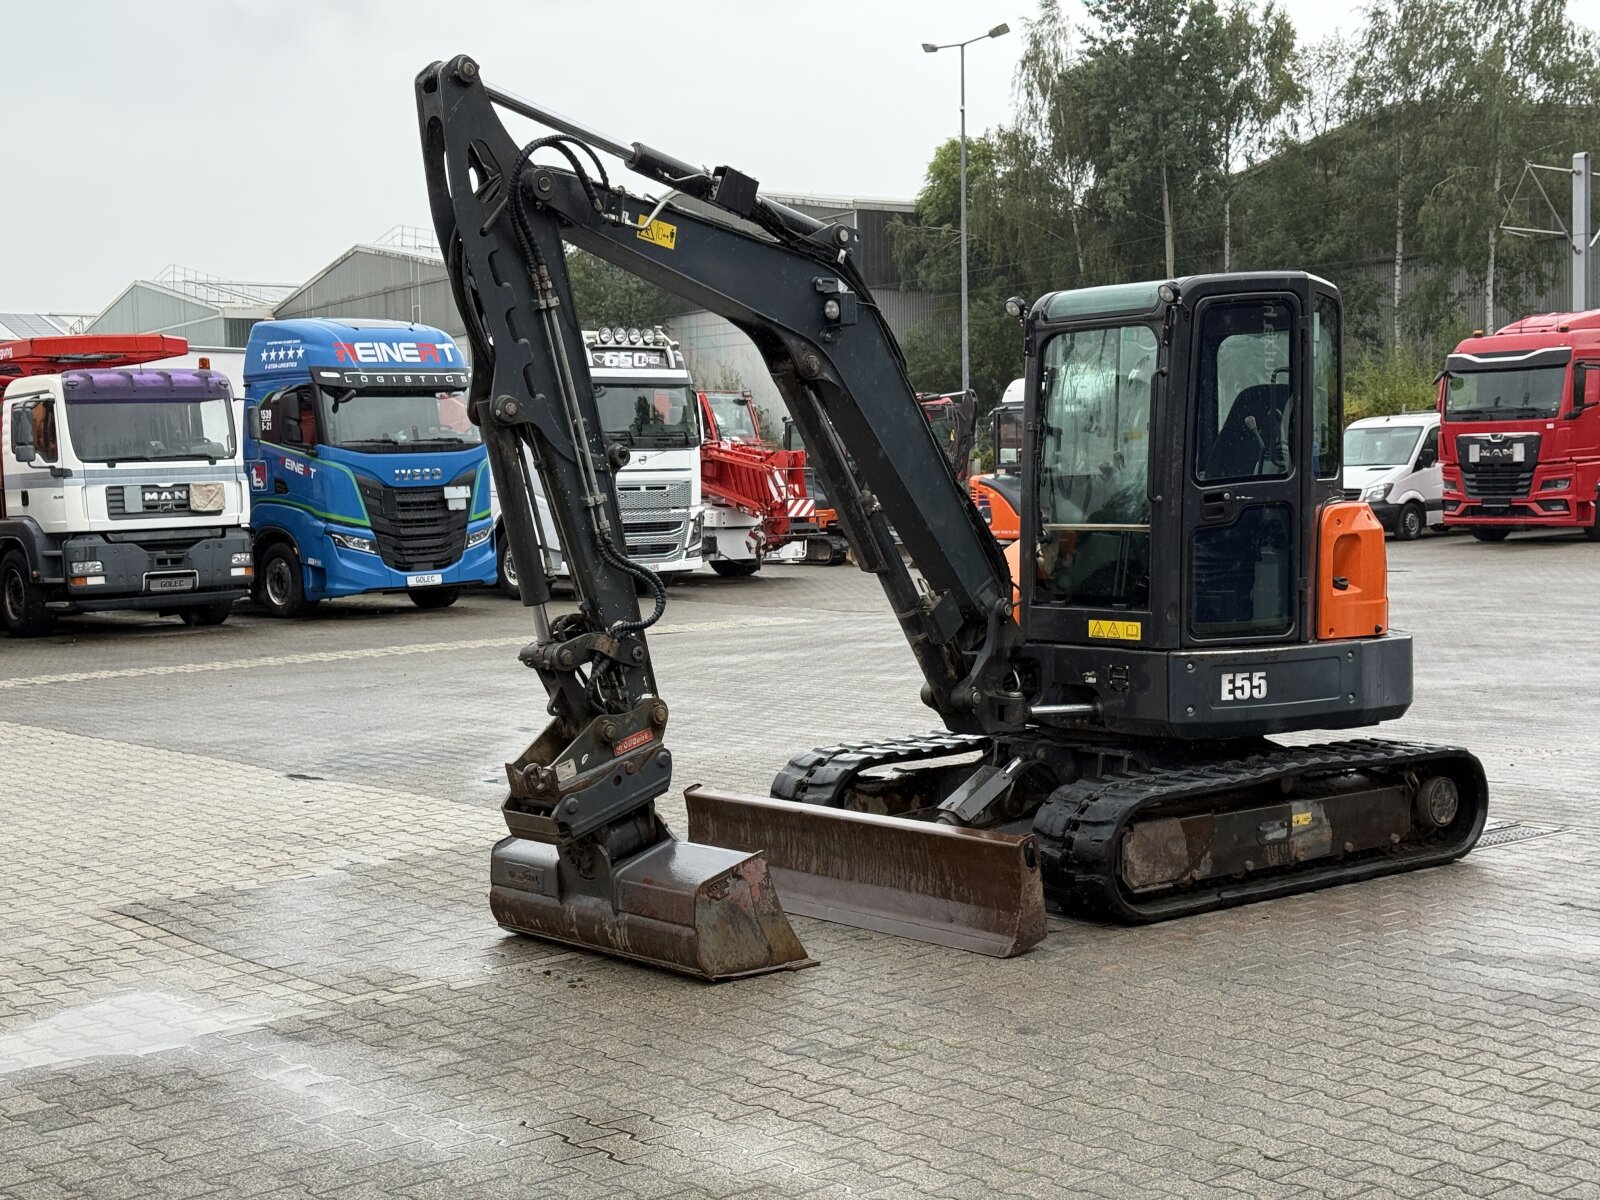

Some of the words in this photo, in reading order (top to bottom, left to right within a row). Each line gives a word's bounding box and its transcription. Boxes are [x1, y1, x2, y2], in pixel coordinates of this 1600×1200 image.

[332, 342, 454, 362] REINERT
[344, 375, 468, 383] LOGISTICS
[394, 468, 442, 481] IVECO
[144, 490, 187, 501] MAN
[160, 579, 184, 588] GOLEC
[415, 575, 435, 583] GOLEC
[1220, 671, 1268, 701] E55
